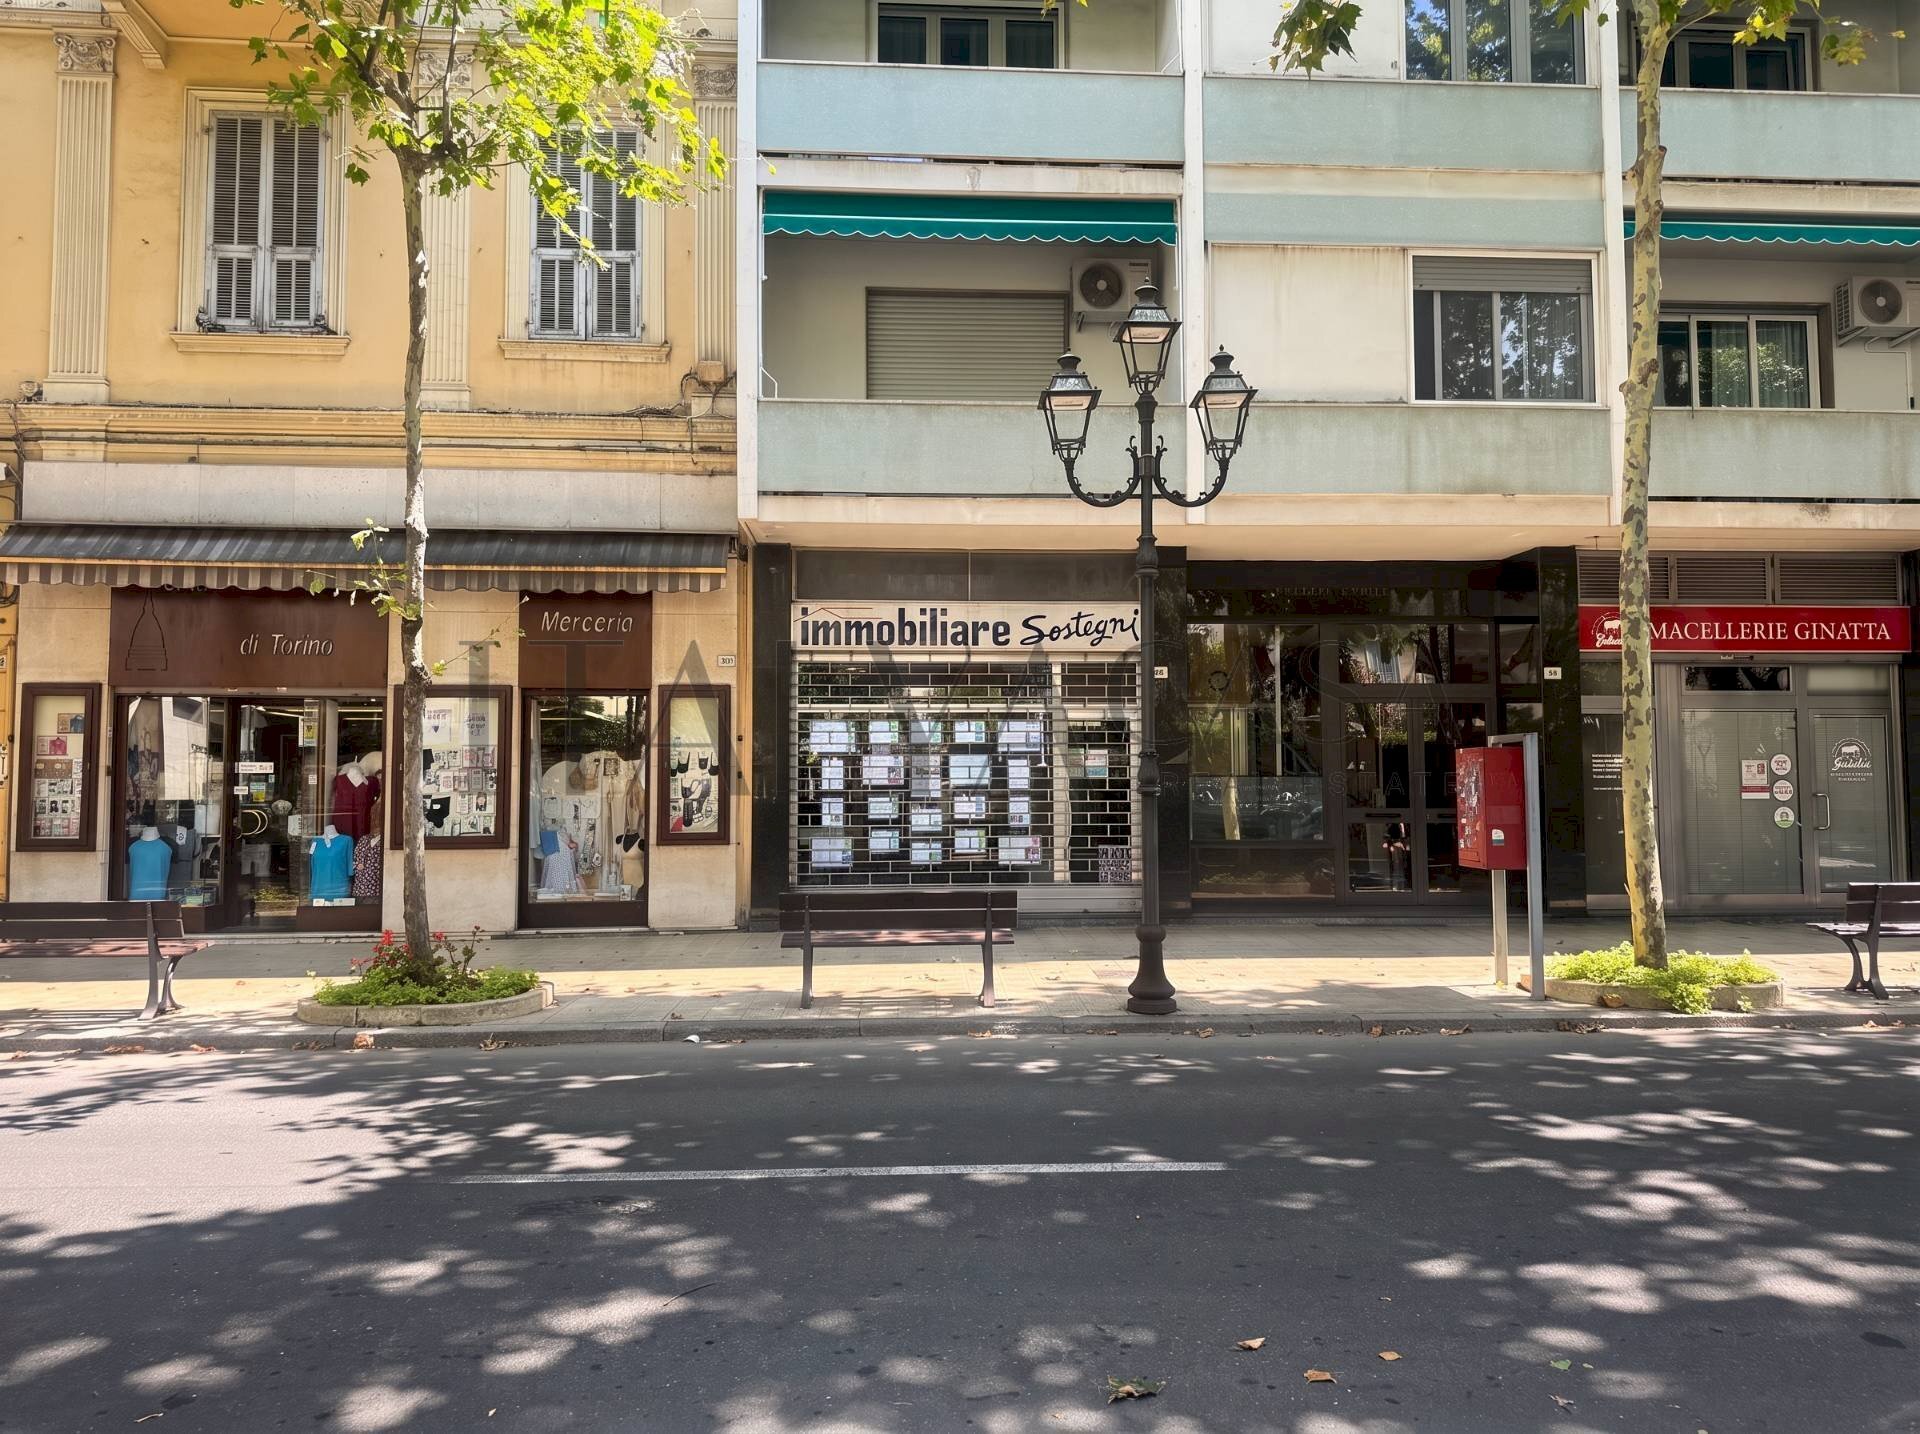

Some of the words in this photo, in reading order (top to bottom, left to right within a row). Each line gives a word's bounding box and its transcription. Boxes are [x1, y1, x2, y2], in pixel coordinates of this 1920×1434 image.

[541, 610, 634, 634] Merceria
[801, 607, 1010, 646] immobiliare
[1020, 608, 1140, 646] Sostegni
[1649, 621, 1789, 641] MACELLERIE
[1794, 621, 1891, 641] GINATTA
[239, 632, 259, 656] di
[271, 632, 335, 656] Torino
